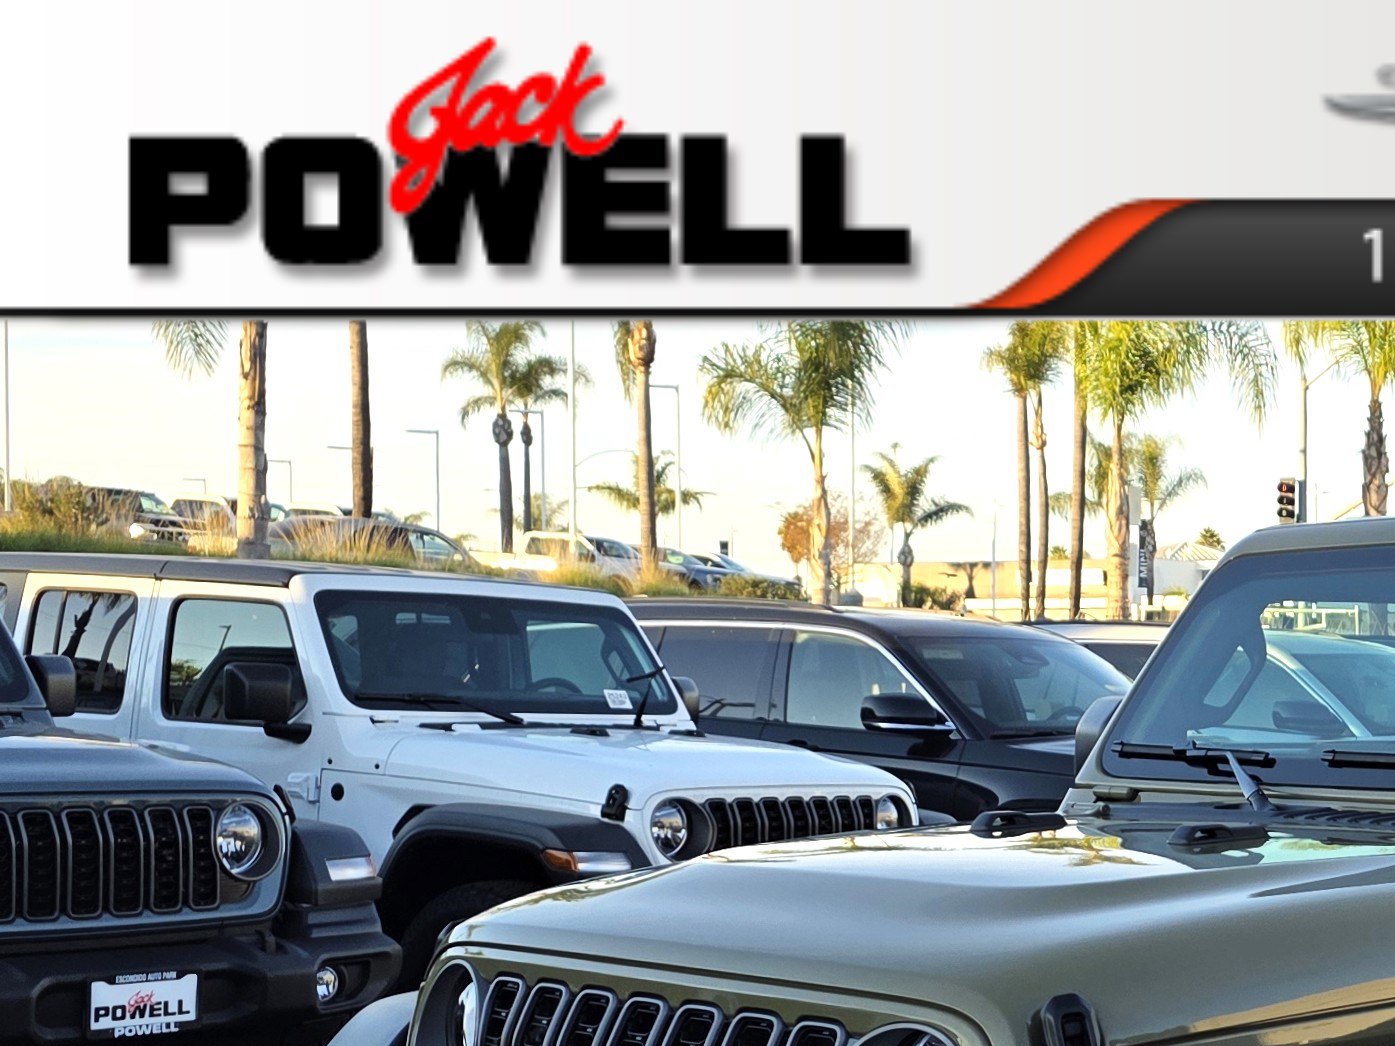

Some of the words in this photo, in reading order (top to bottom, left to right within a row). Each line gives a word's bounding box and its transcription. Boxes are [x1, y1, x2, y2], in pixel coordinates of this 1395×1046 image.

[93, 999, 191, 1023] POWELL
[127, 990, 155, 1014] Jack
[114, 1021, 180, 1039] POWELL
